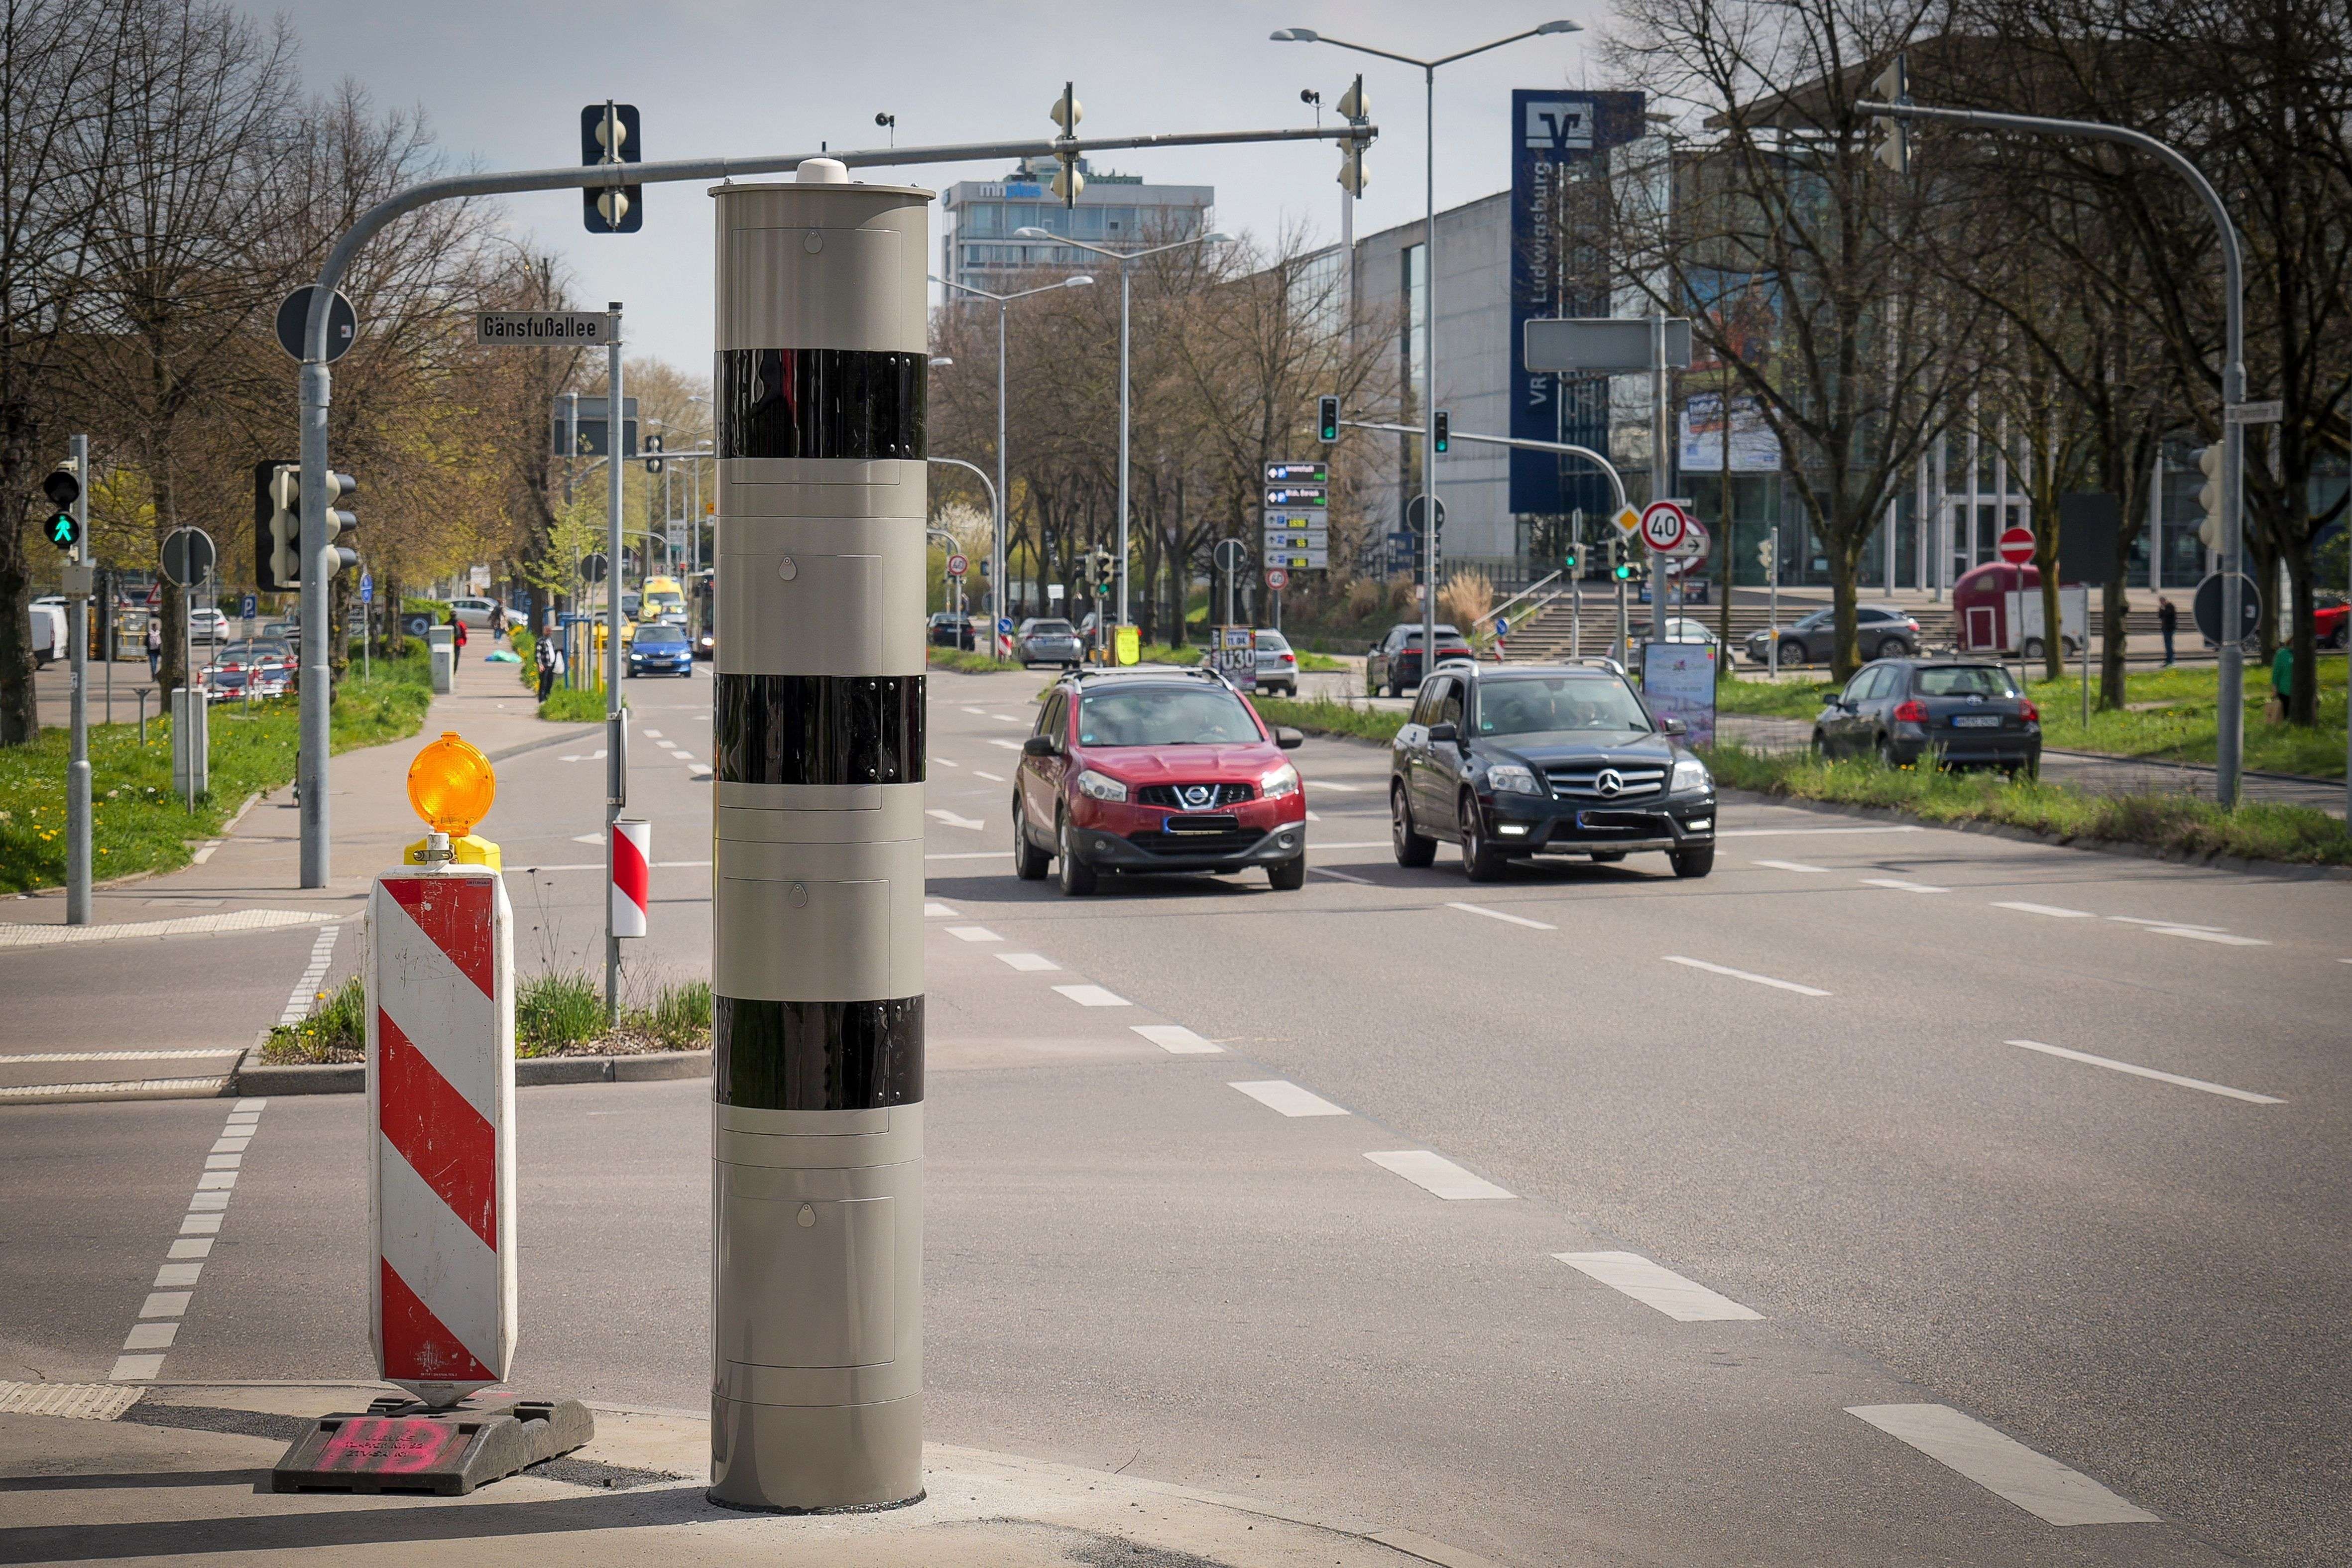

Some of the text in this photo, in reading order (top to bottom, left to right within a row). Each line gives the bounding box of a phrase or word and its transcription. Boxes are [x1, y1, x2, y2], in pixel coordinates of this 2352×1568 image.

[483, 316, 596, 337] Gänsfußallee
[1651, 515, 1677, 537] 40
[953, 560, 964, 570] 40
[1272, 574, 1283, 583] 40
[243, 598, 253, 617] P
[1220, 649, 1255, 670] Ü30
